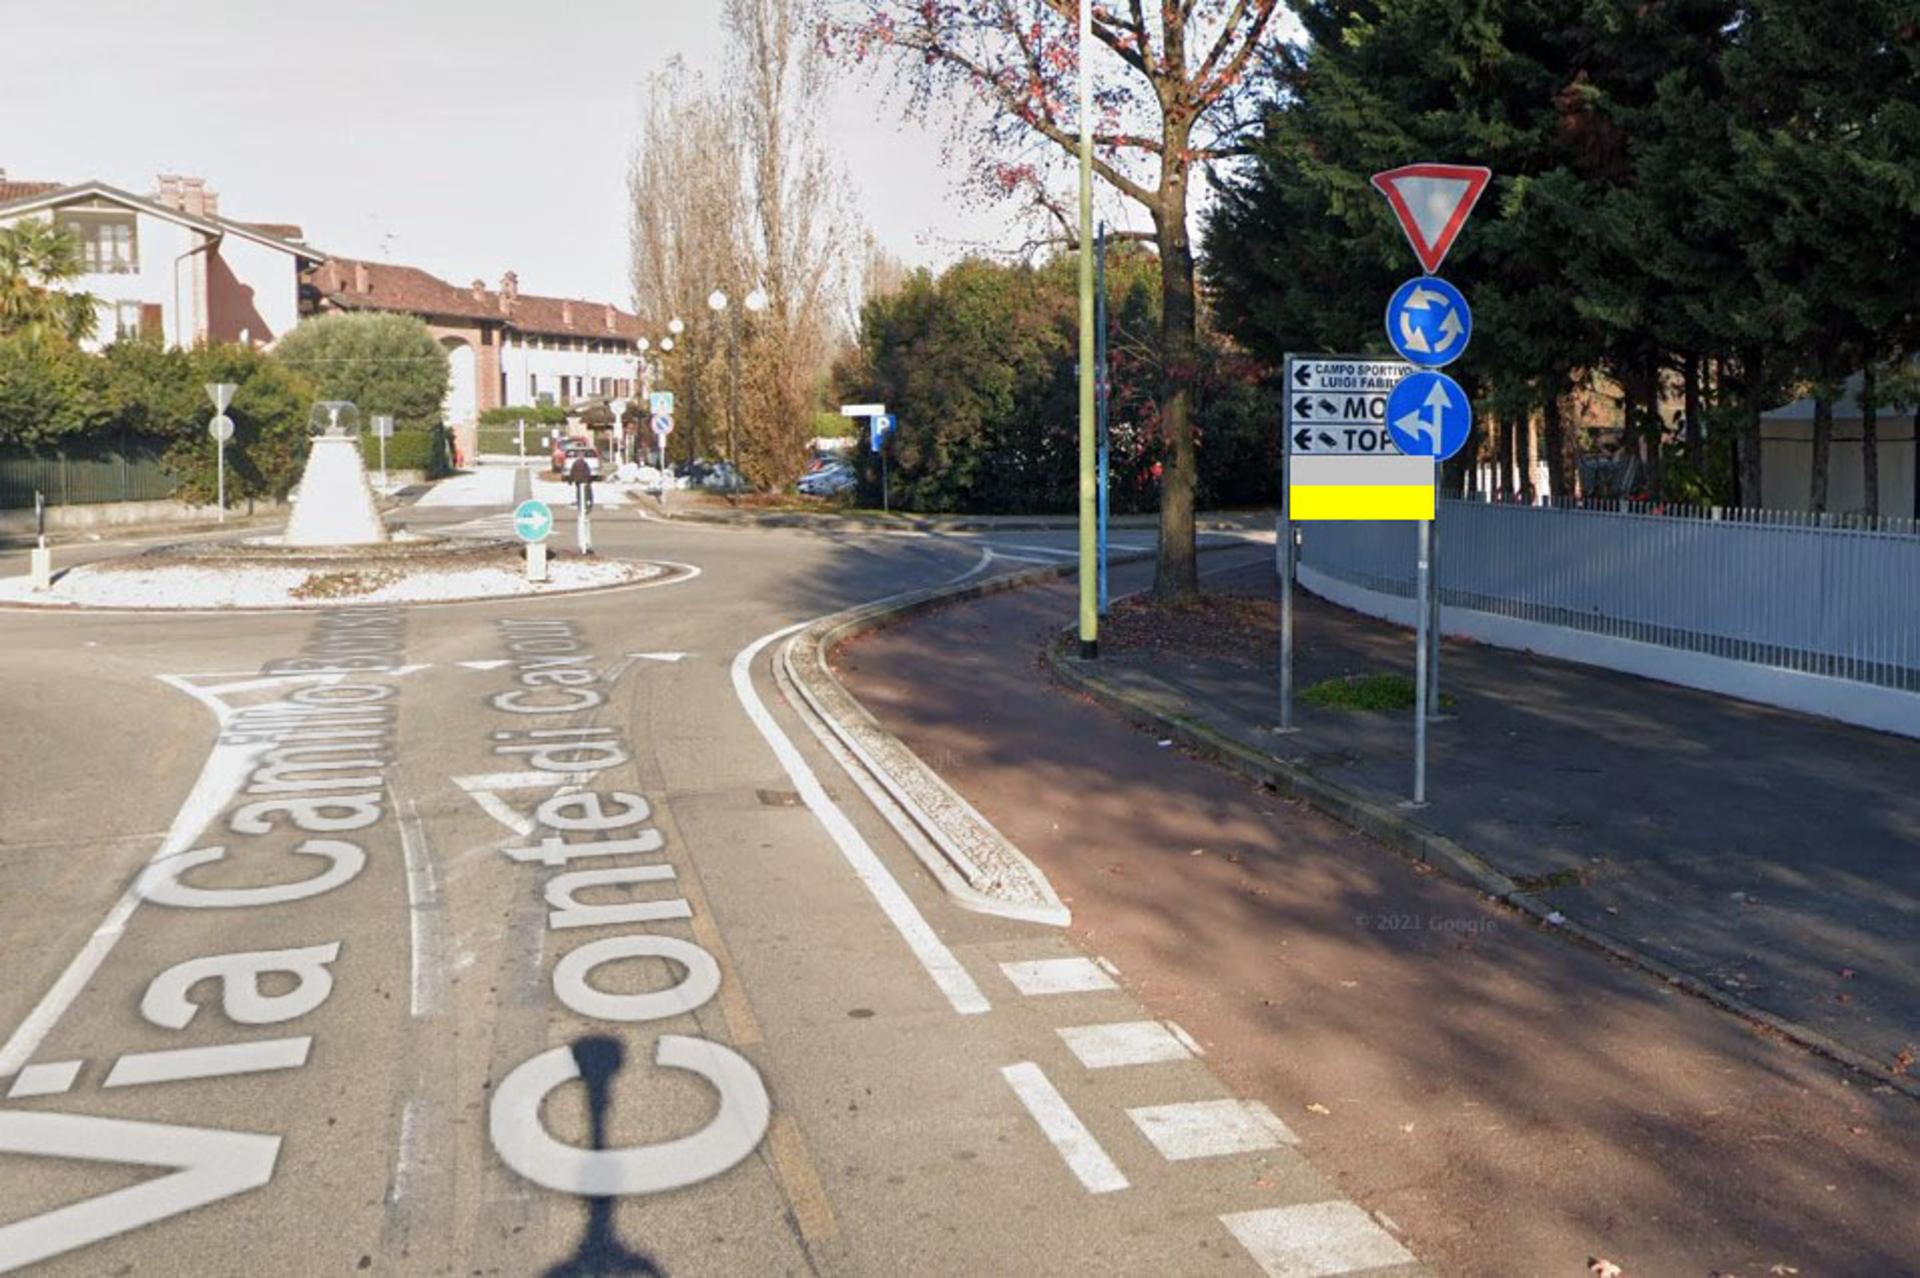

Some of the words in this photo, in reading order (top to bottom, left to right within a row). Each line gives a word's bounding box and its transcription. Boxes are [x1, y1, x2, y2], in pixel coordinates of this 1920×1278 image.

[1315, 364, 1355, 375] CAMPO
[1358, 364, 1413, 377] SPORTIVO
[1321, 376, 1357, 388] LUIGI
